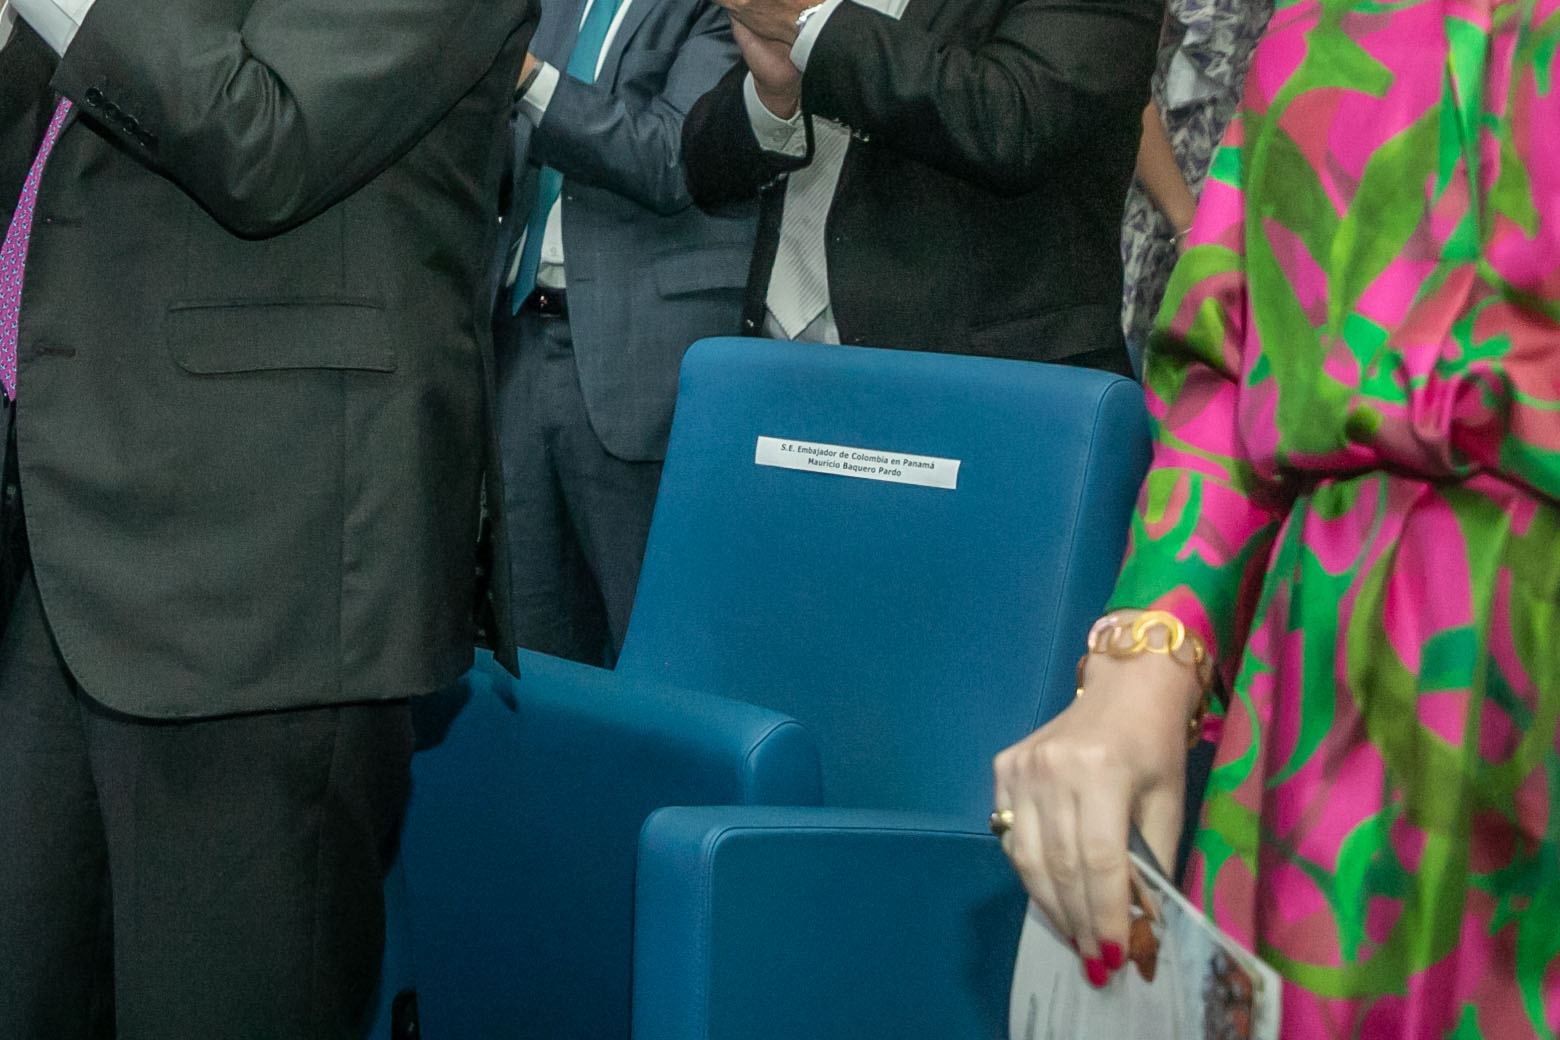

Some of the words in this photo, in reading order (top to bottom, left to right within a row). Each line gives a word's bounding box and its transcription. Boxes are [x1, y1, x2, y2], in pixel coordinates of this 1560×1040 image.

[781, 443, 794, 452] S.E.
[798, 446, 837, 457] Embajador
[852, 452, 888, 464] Colombia
[903, 459, 934, 469] Panamá
[808, 458, 840, 468] Mauricio
[843, 462, 876, 473] Baquero
[878, 467, 901, 476] Pardo
